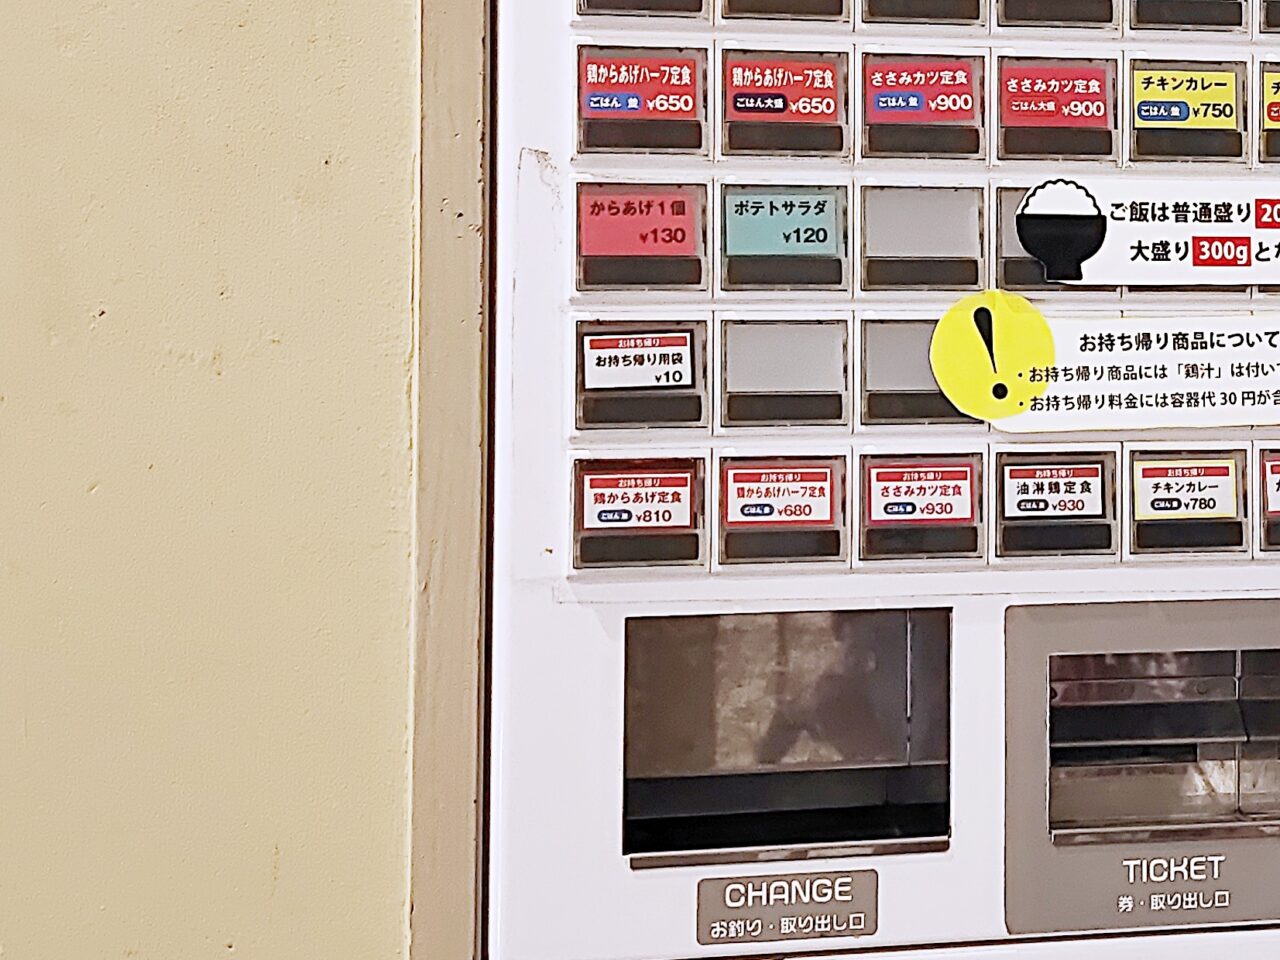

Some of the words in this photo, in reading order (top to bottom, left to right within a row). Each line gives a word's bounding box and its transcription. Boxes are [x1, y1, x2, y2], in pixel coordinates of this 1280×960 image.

[586, 64, 691, 85] 鶏からあげハーフ定食
[871, 70, 968, 86] ささみカツ定食
[1006, 77, 1100, 94] ささみカツ定食
[1141, 76, 1228, 92] チキンカレー
[646, 94, 694, 111] ¥650
[789, 97, 836, 115] ¥650
[928, 94, 972, 111] ¥900
[1061, 101, 1104, 117] ¥900
[1193, 103, 1234, 118] ¥750
[734, 199, 828, 215] ポテトサラダ
[640, 228, 686, 244] ¥130
[783, 228, 828, 244] ¥120
[1079, 331, 1280, 353] お持ち帰り商品について
[655, 371, 683, 383] ¥10
[880, 484, 963, 497] ささみカツ定食
[1152, 481, 1219, 493] チキンカレー
[778, 504, 812, 517] ¥680
[919, 503, 953, 515] ¥930
[1051, 500, 1085, 511] ¥930
[1184, 497, 1216, 510] ¥780
[635, 510, 672, 523] ¥810
[1123, 856, 1225, 883] TICKET
[725, 879, 853, 908] CHANGE
